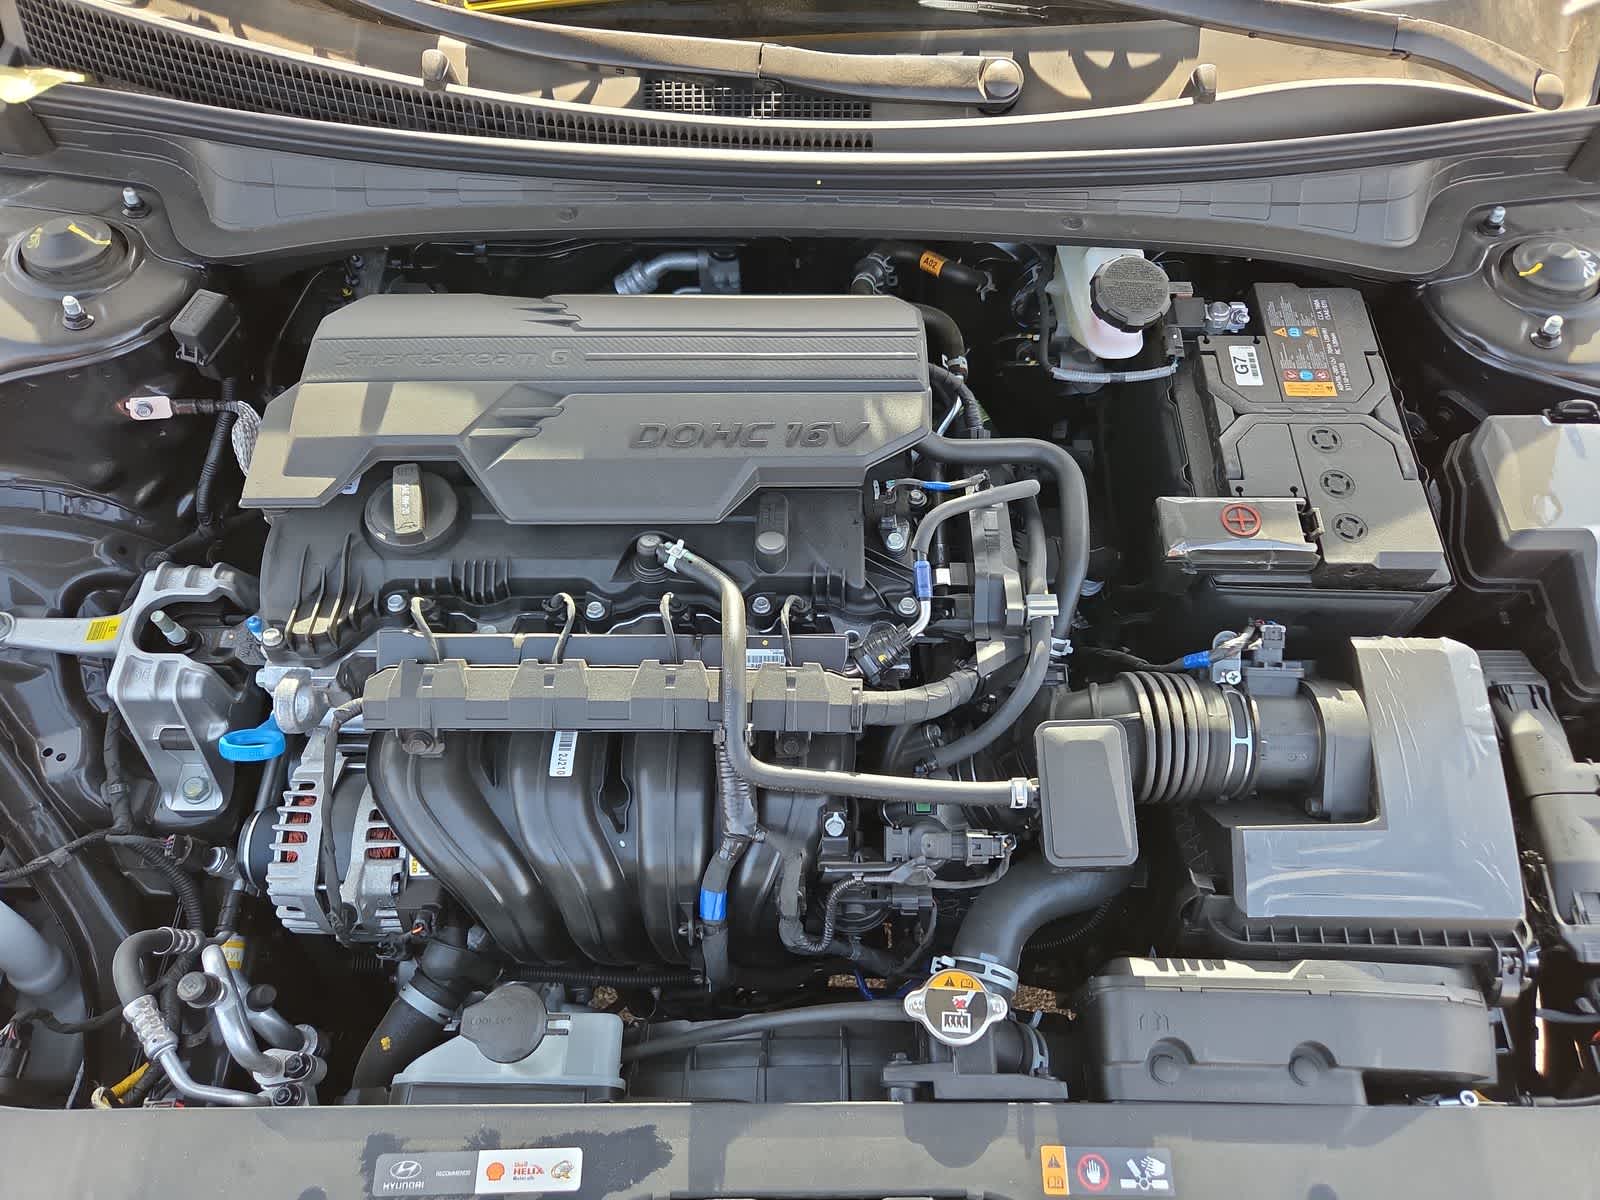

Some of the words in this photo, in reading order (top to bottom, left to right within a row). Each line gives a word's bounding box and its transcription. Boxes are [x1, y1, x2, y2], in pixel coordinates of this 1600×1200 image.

[334, 349, 540, 369] Smartstream
[545, 348, 570, 368] G
[1233, 356, 1249, 375] G7
[629, 421, 776, 449] DOHC
[785, 421, 871, 449] 16V
[555, 753, 569, 776] 2J210
[513, 1167, 544, 1176] HELIX
[382, 1181, 424, 1191] HYUNDAI
